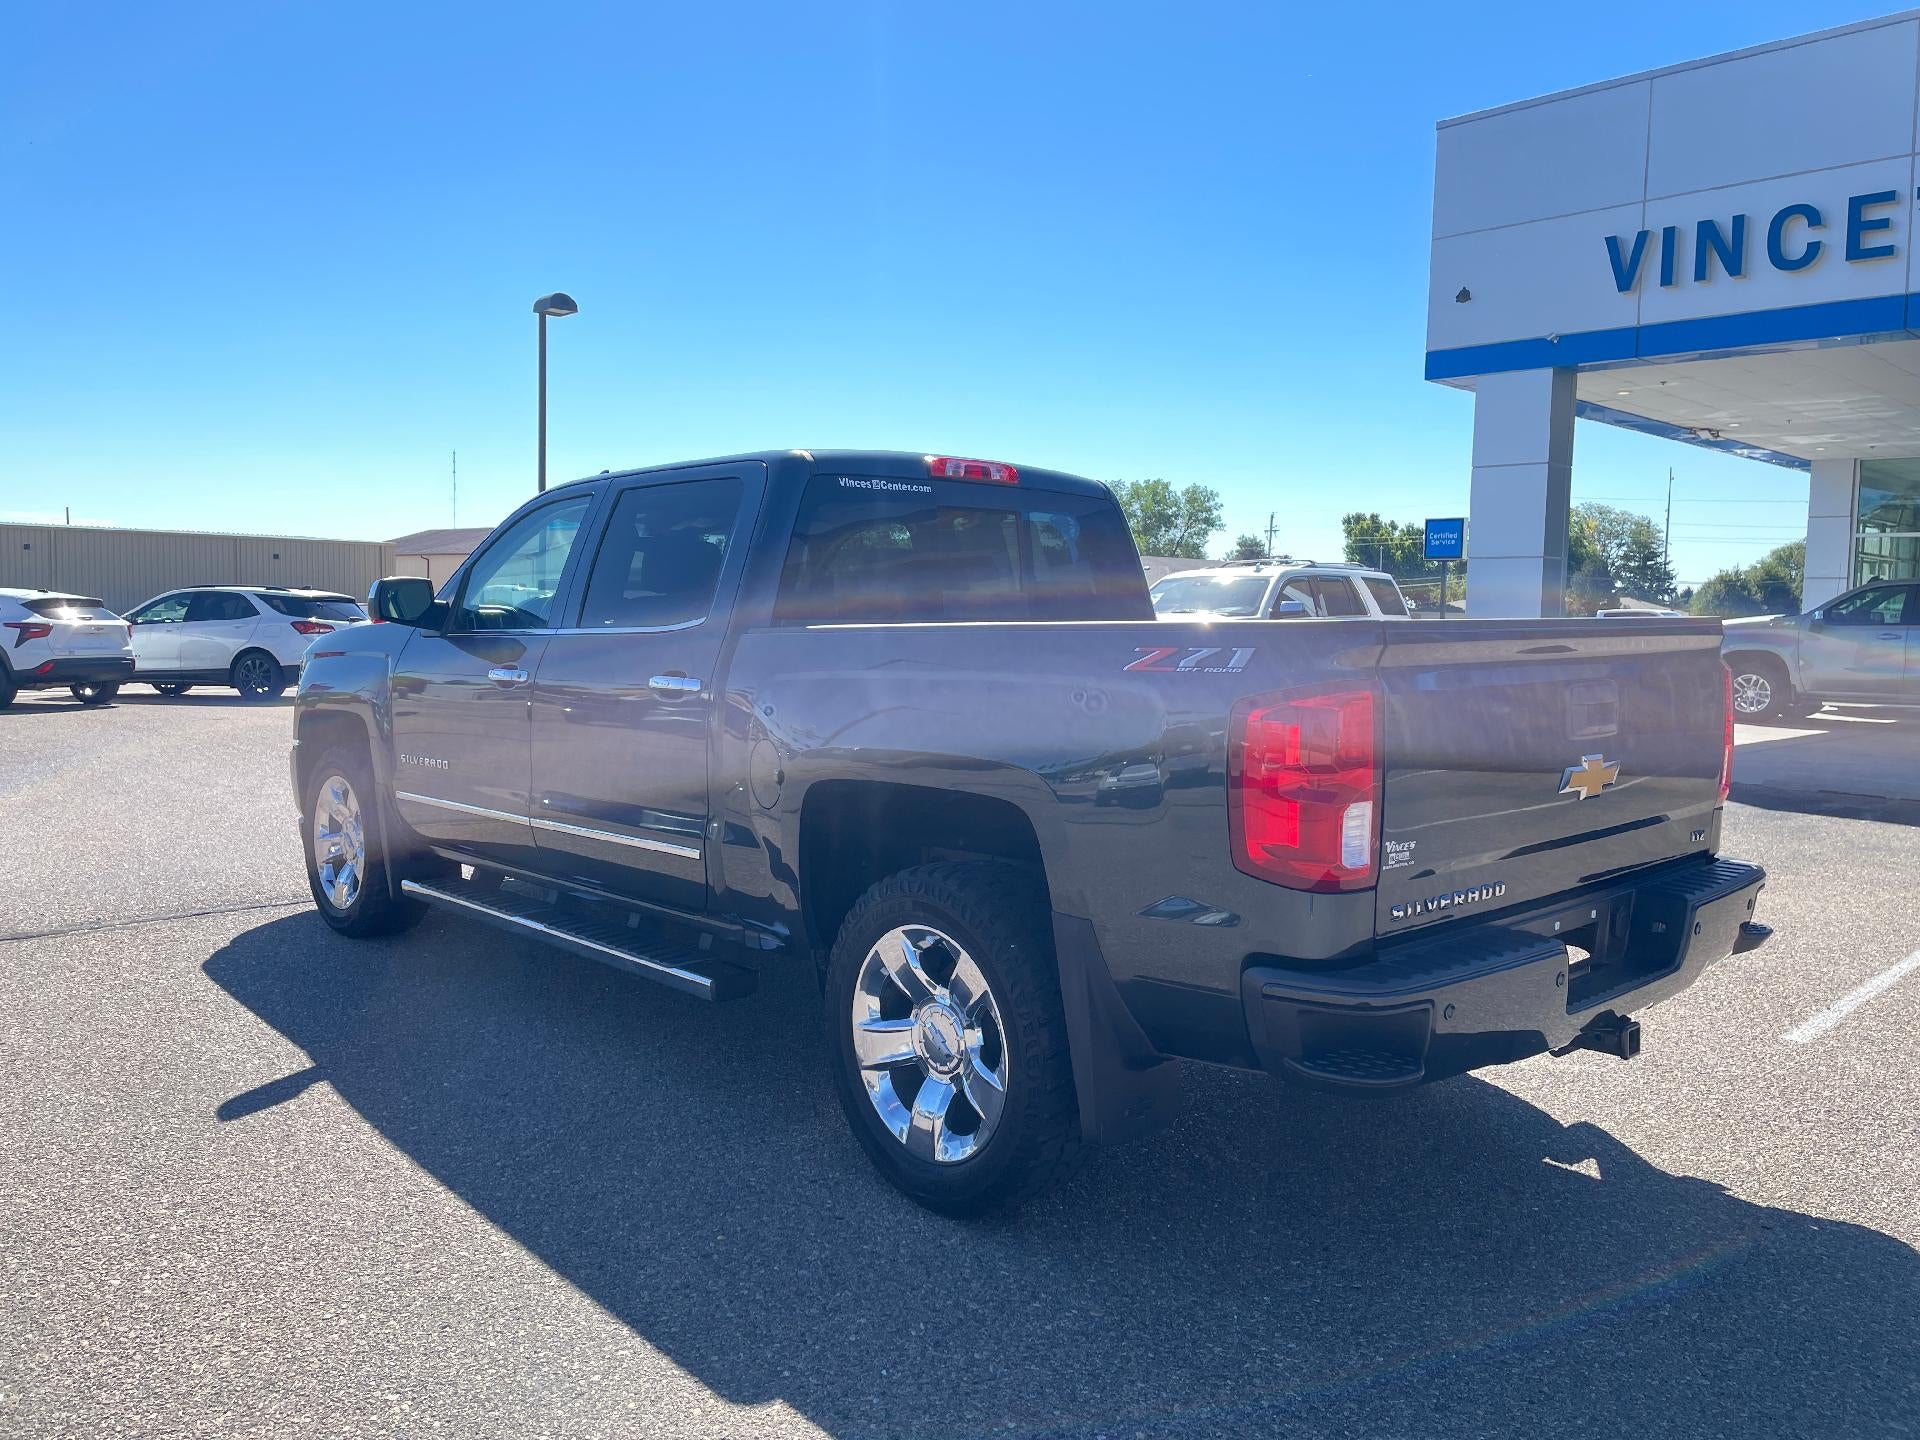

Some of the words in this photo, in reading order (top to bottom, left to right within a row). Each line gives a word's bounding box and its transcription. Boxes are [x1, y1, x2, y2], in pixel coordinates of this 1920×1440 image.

[1605, 187, 1920, 294] VINCE
[1430, 532, 1458, 540] Certified
[1123, 647, 1256, 673] Z71
[400, 754, 449, 770] SILVERADO
[1391, 880, 1506, 922] SILVERADO
